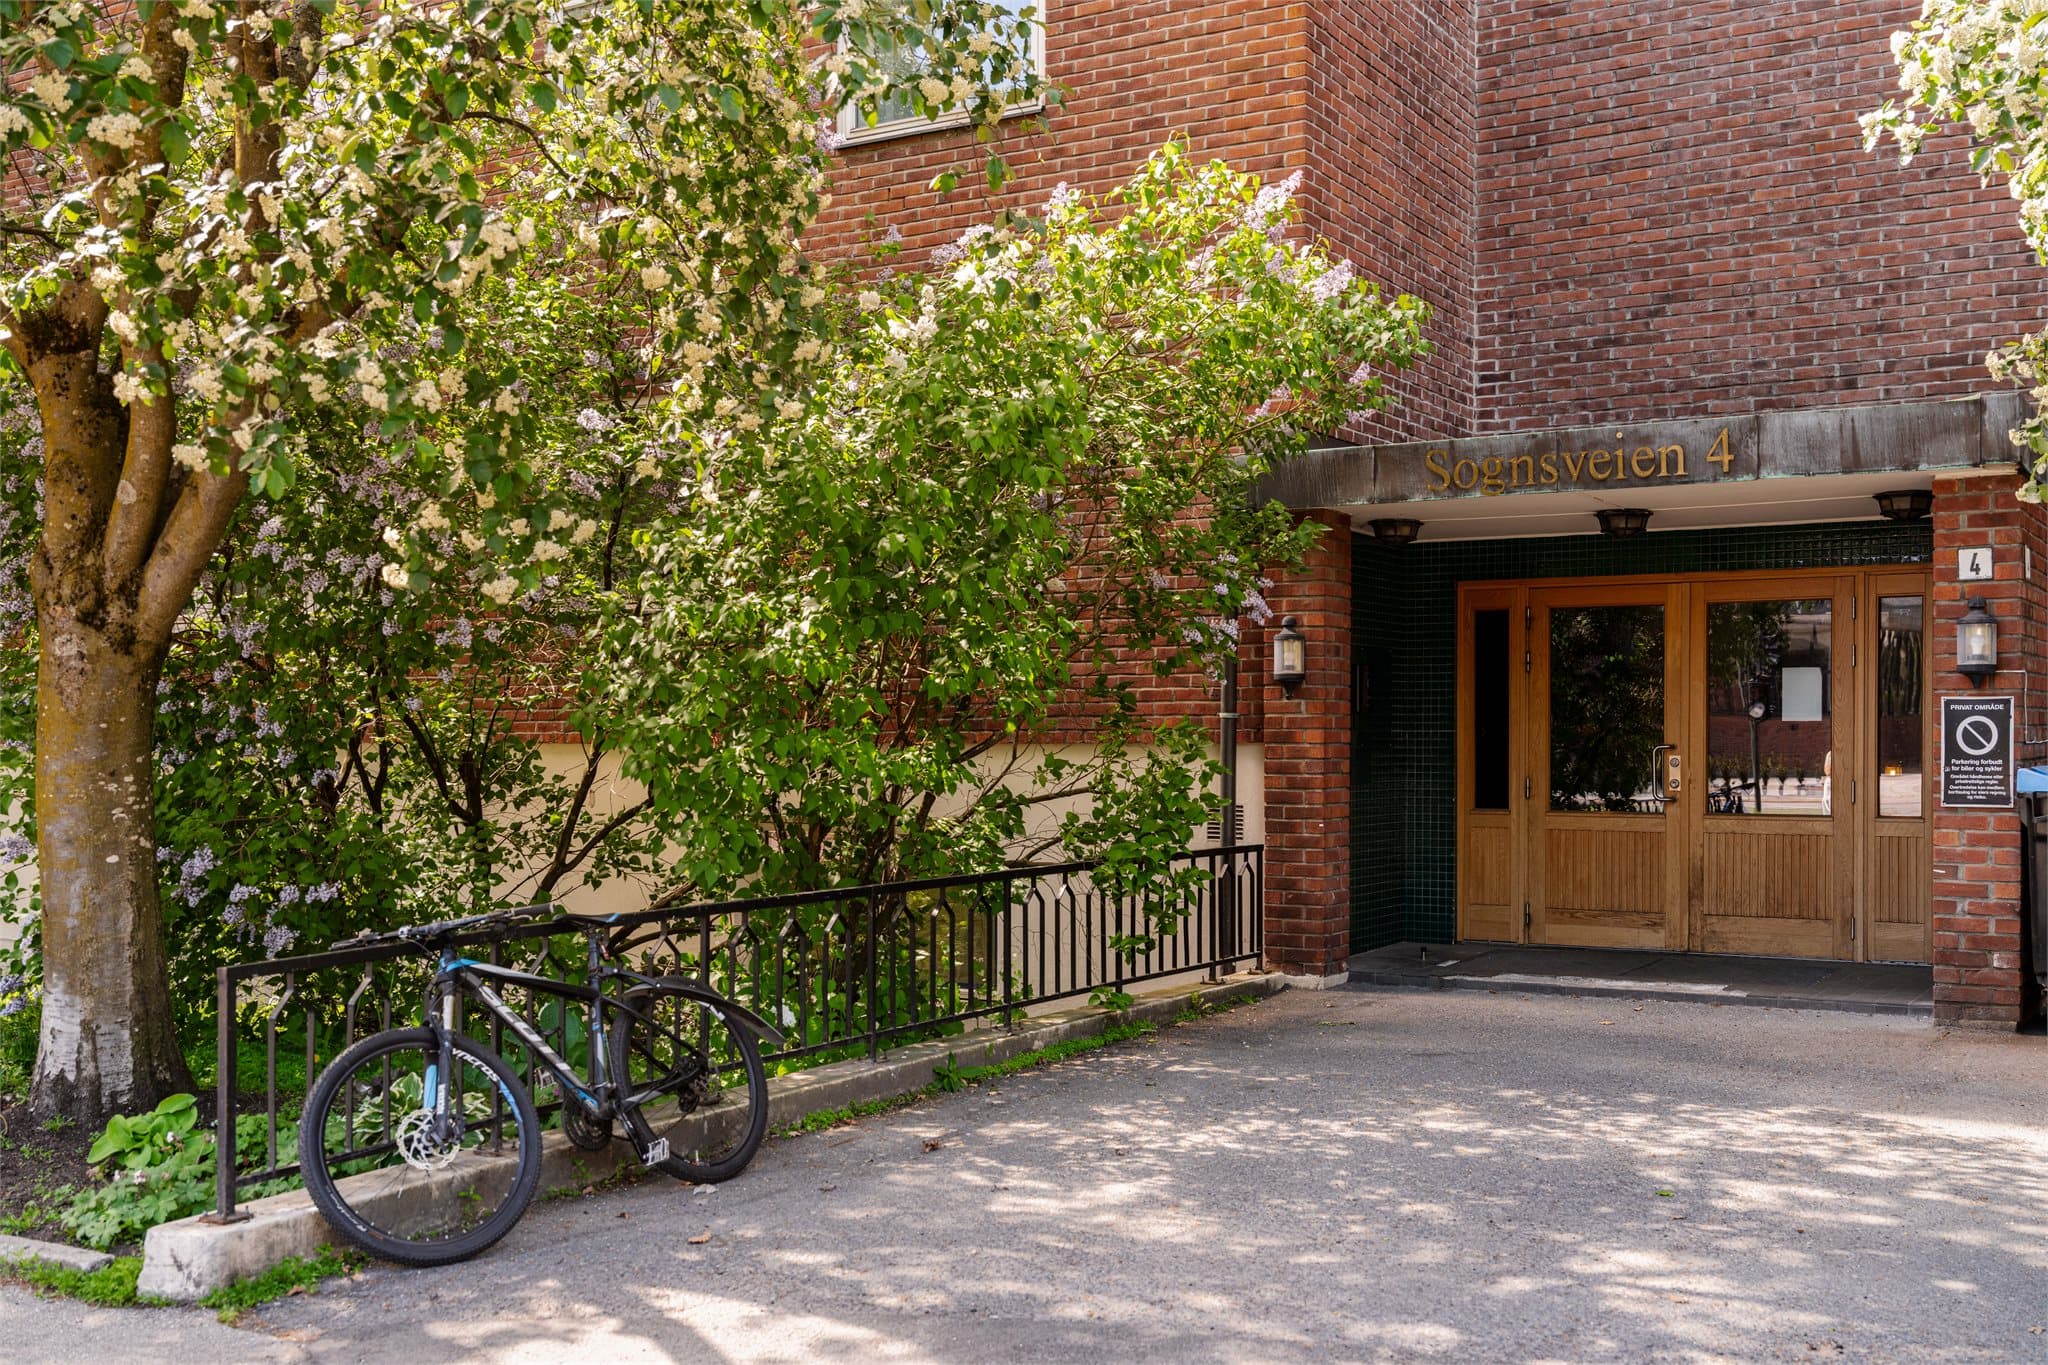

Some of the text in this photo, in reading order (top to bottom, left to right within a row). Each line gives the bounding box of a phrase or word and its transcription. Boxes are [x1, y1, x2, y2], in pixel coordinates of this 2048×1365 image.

[1424, 427, 1735, 497] Sognsveien 4
[1969, 552, 1981, 575] 4
